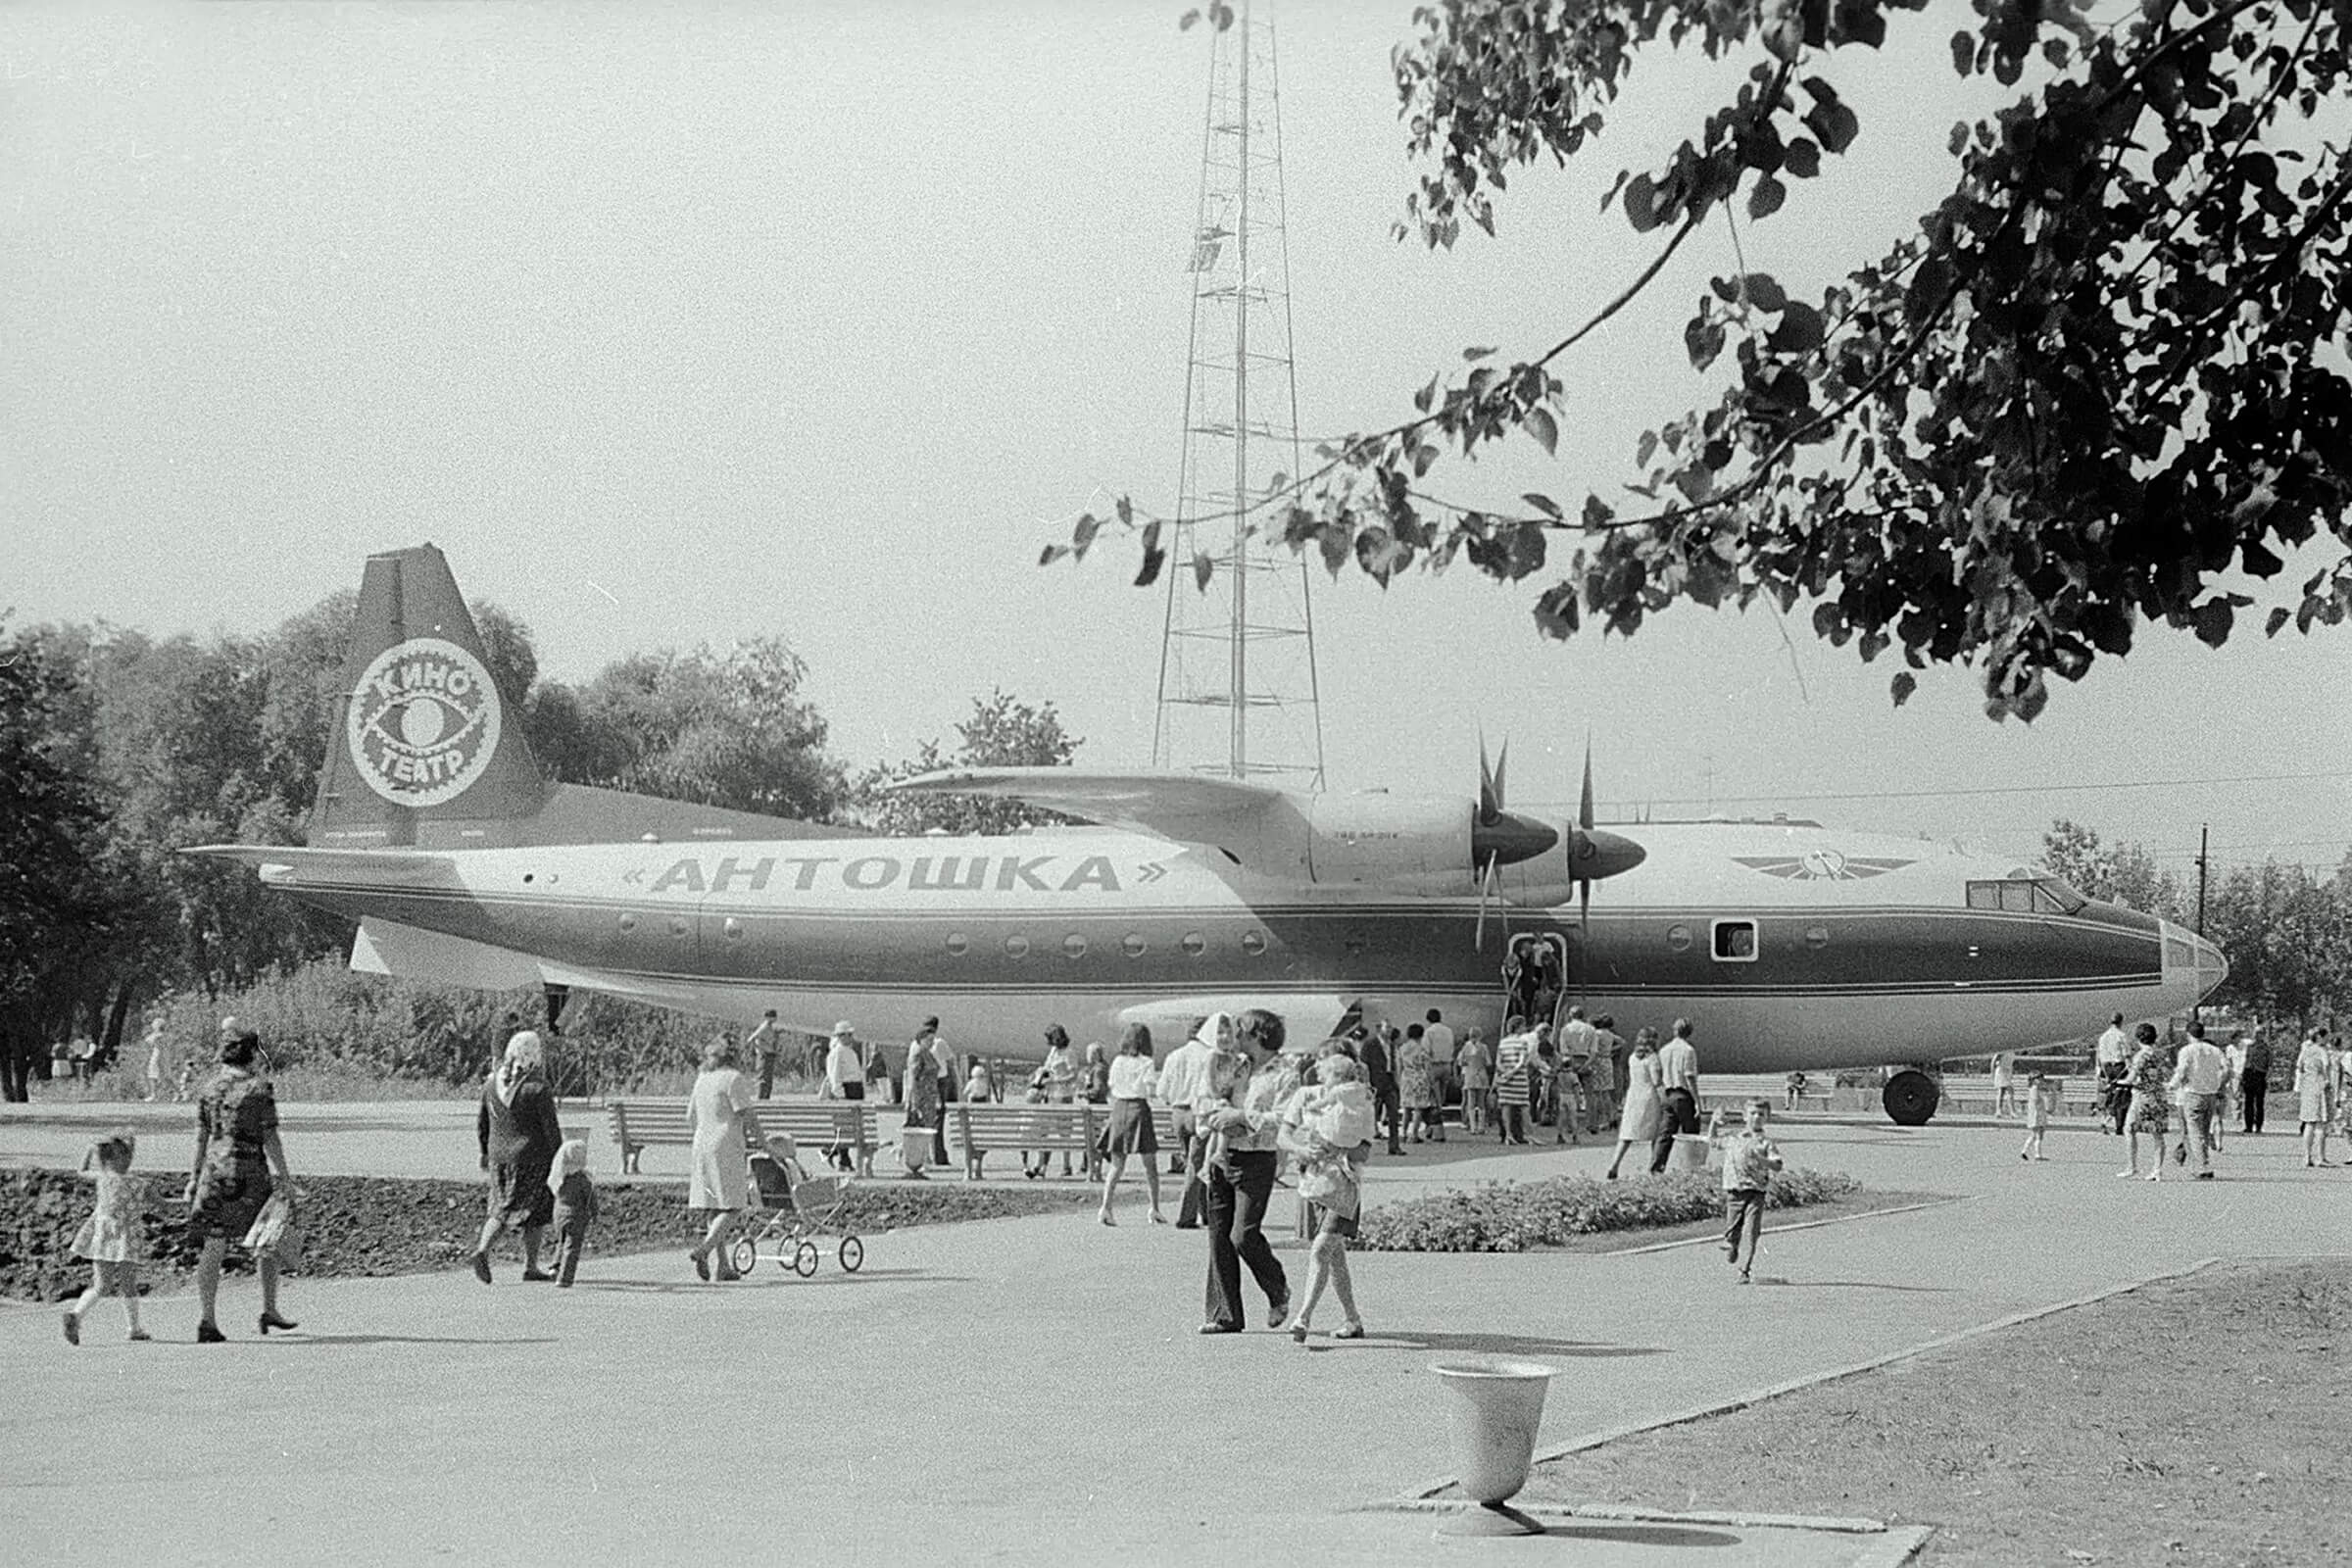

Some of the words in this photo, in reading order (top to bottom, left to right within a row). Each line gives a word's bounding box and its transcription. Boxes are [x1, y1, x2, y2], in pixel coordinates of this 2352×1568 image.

[374, 662, 470, 701] КИНО
[379, 747, 465, 782] ТЕАТР
[622, 856, 1168, 892] «АНТОШКА»
